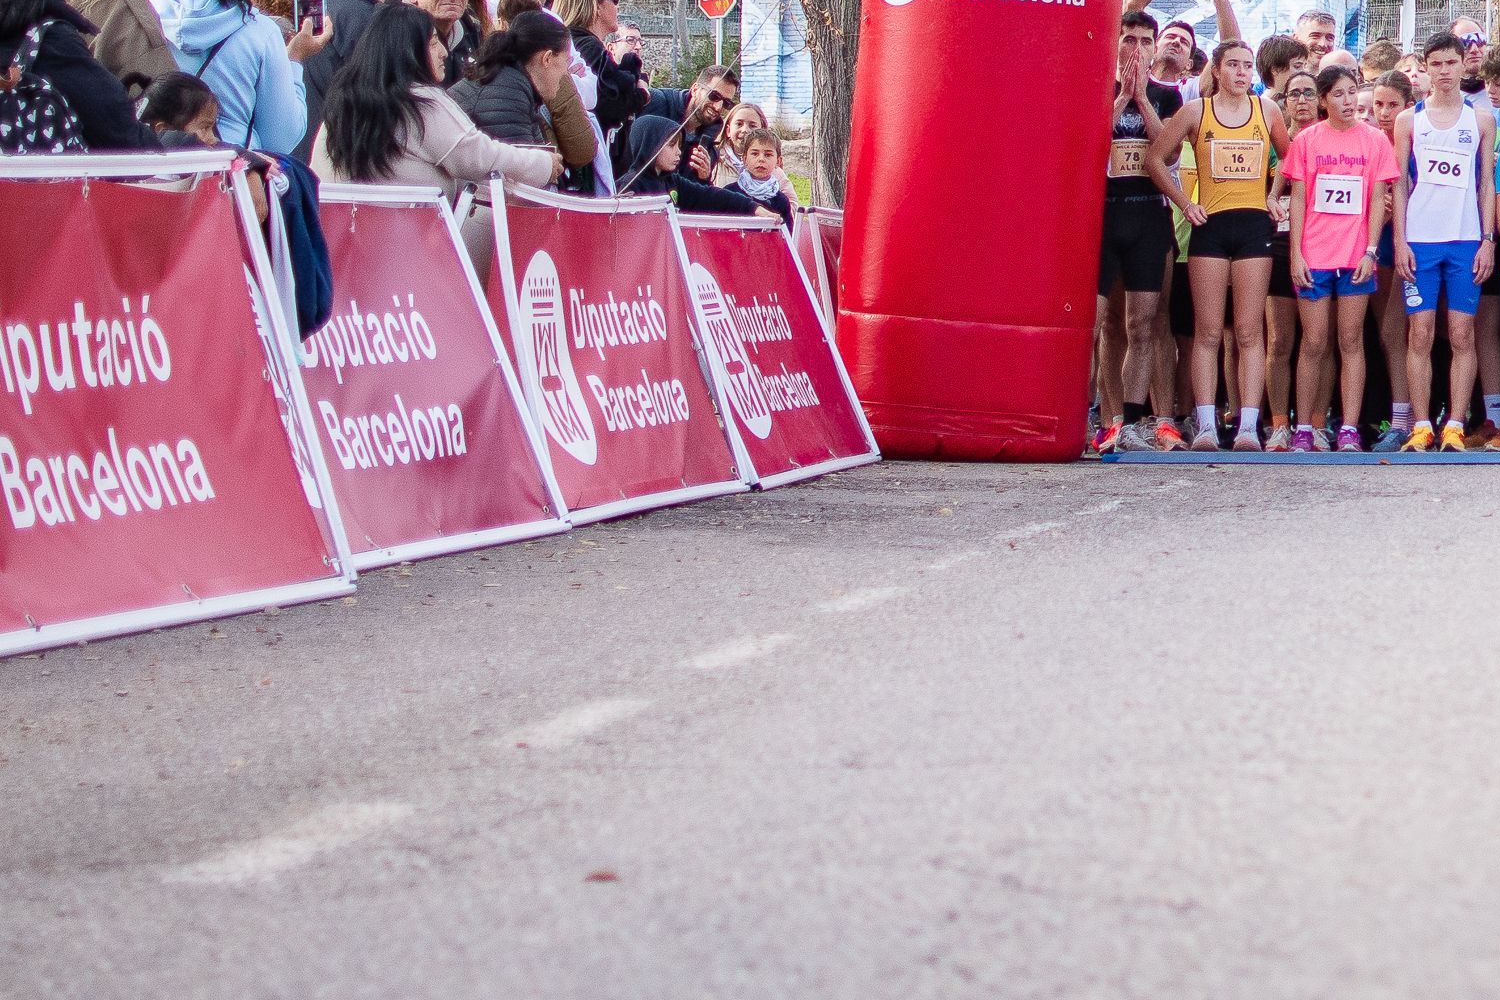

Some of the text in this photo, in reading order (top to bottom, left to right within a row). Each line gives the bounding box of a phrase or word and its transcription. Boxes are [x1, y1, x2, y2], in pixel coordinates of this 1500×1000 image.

[1124, 152, 1140, 161] 78
[1231, 153, 1244, 163] 16
[1316, 155, 1337, 167] Milla
[1427, 159, 1461, 177] 706
[1325, 189, 1351, 203] 721
[570, 285, 667, 360] Diputació
[725, 293, 792, 354] Diputació
[586, 369, 690, 432] Barcelona
[753, 362, 820, 412] Barcelona
[318, 394, 467, 469] Barcelona
[0, 428, 215, 529] Barcelona
